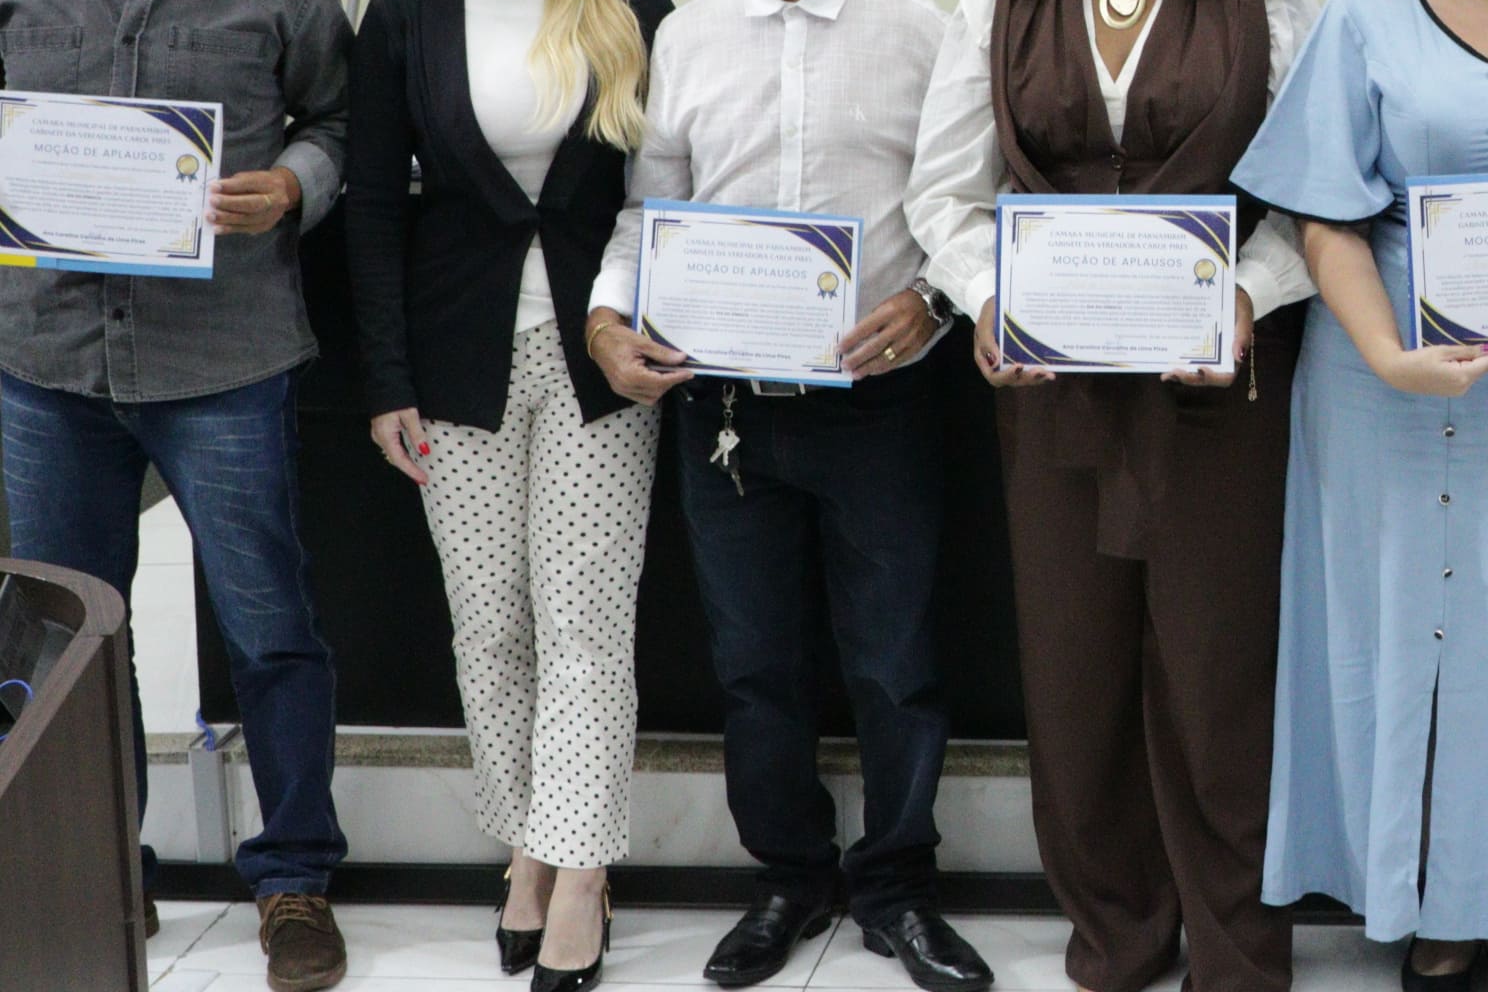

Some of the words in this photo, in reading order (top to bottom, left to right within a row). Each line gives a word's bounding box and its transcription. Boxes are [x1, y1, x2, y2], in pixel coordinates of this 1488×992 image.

[34, 143, 80, 158] MOÇÃO
[84, 147, 98, 157] DE
[103, 149, 165, 162] APLAUSOS
[1053, 255, 1098, 268] MOÇÃO
[1103, 257, 1117, 266] DE
[1122, 258, 1183, 267] APLAUSOS
[686, 262, 729, 276] MOÇÃO
[733, 266, 746, 275] DE
[750, 267, 808, 279] APLAUSOS
